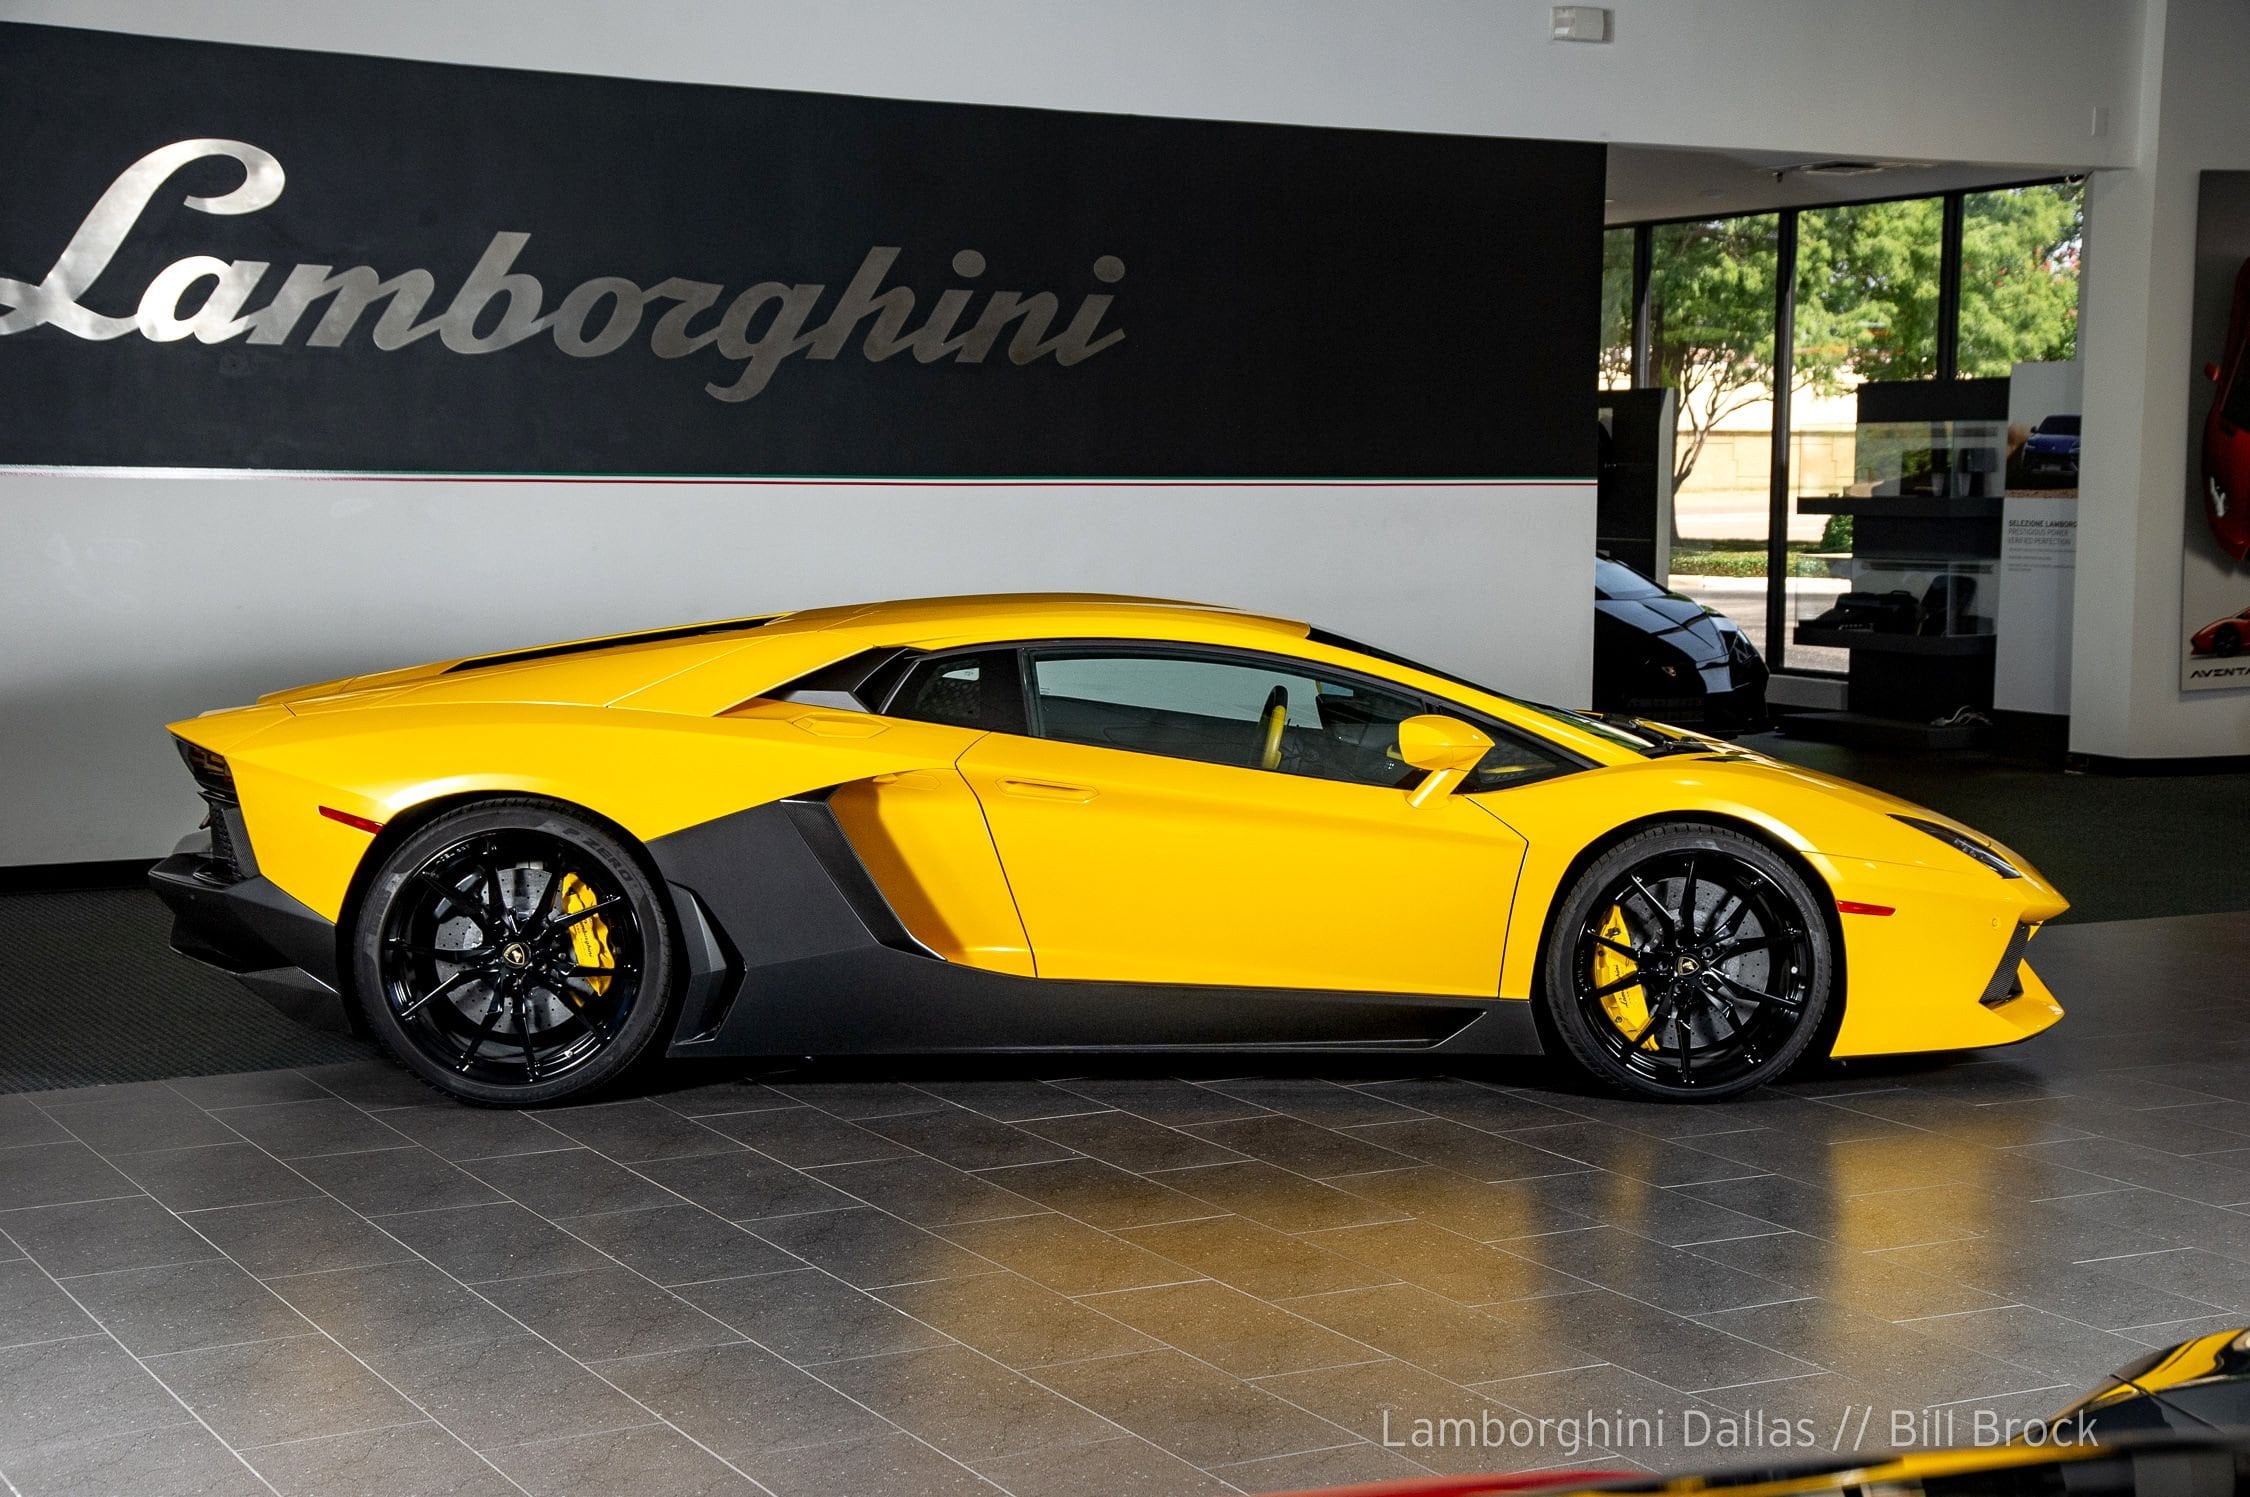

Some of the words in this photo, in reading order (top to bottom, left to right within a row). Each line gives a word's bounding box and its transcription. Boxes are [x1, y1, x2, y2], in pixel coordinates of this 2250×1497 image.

[0, 138, 1126, 402] Lamborghini
[2008, 528, 2046, 536] PRESTIGIOUS
[2047, 528, 2069, 537] POWER
[2034, 537, 2071, 546] PERFECTION
[582, 837, 634, 882] ZERO
